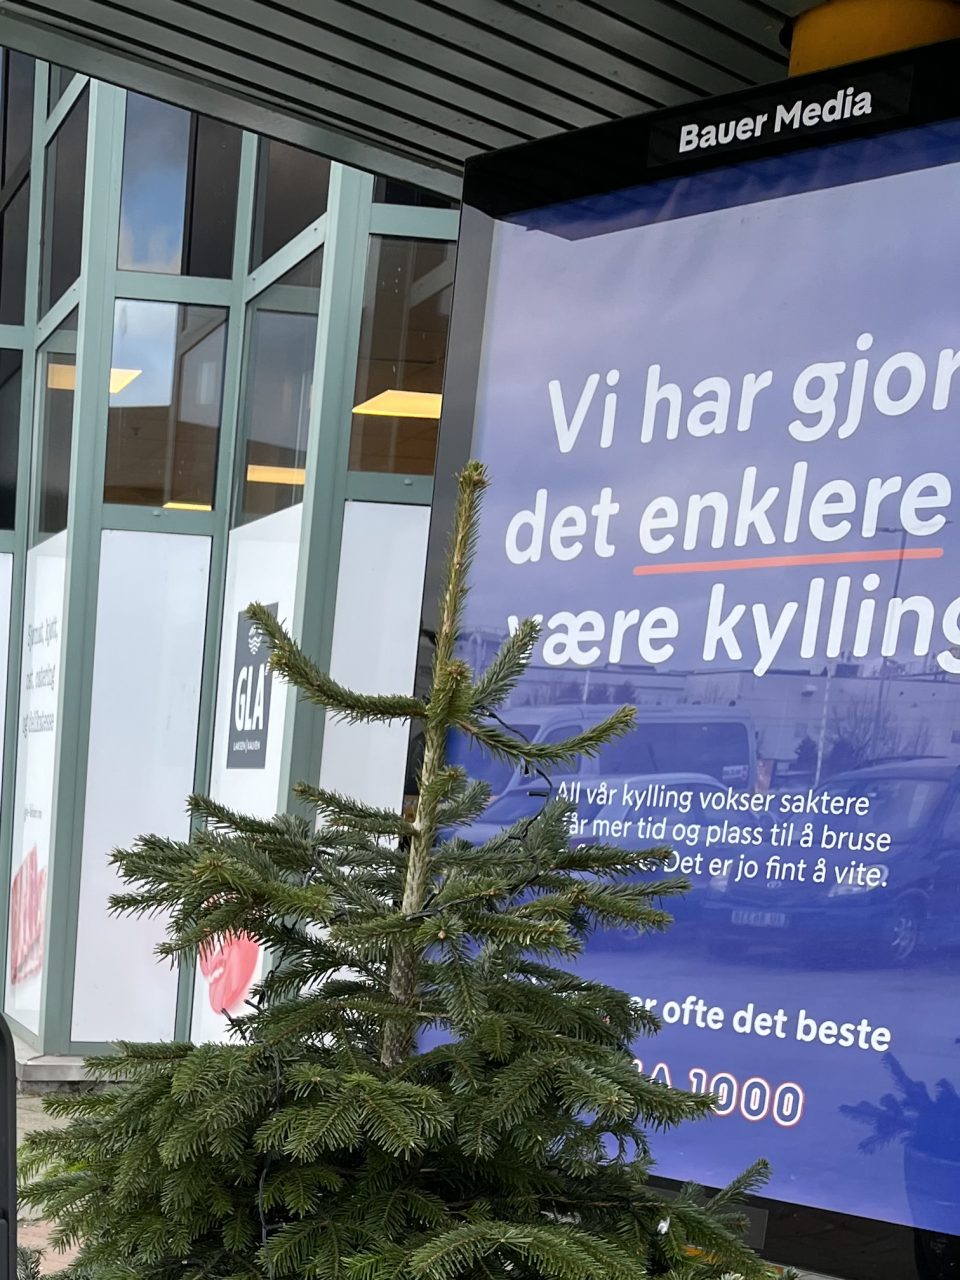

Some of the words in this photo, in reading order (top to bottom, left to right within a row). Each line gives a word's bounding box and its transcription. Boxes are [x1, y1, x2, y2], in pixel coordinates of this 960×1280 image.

[679, 113, 768, 153] Bauer
[774, 87, 872, 133] Media
[548, 368, 620, 453] Vi
[640, 363, 773, 444] har
[505, 487, 620, 564] det
[639, 461, 952, 554] enklere
[556, 781, 581, 804] All
[586, 782, 617, 806] vår
[622, 784, 693, 813] kylling
[699, 787, 775, 812] vokser
[779, 789, 870, 816] saktere
[592, 817, 632, 838] mer
[637, 817, 668, 840] tid
[672, 822, 701, 847] og
[705, 820, 763, 848] plass
[770, 822, 794, 847] til
[799, 822, 814, 848] å
[821, 824, 891, 852] bruse
[663, 851, 703, 875] Det
[708, 857, 733, 877] er
[734, 853, 758, 882] jo
[766, 855, 807, 882] fint
[812, 857, 827, 883] å
[834, 860, 888, 888] vite.
[662, 995, 725, 1030] ofte
[732, 1003, 788, 1039] det
[796, 1009, 891, 1052] beste
[689, 1067, 804, 1127] 1000
